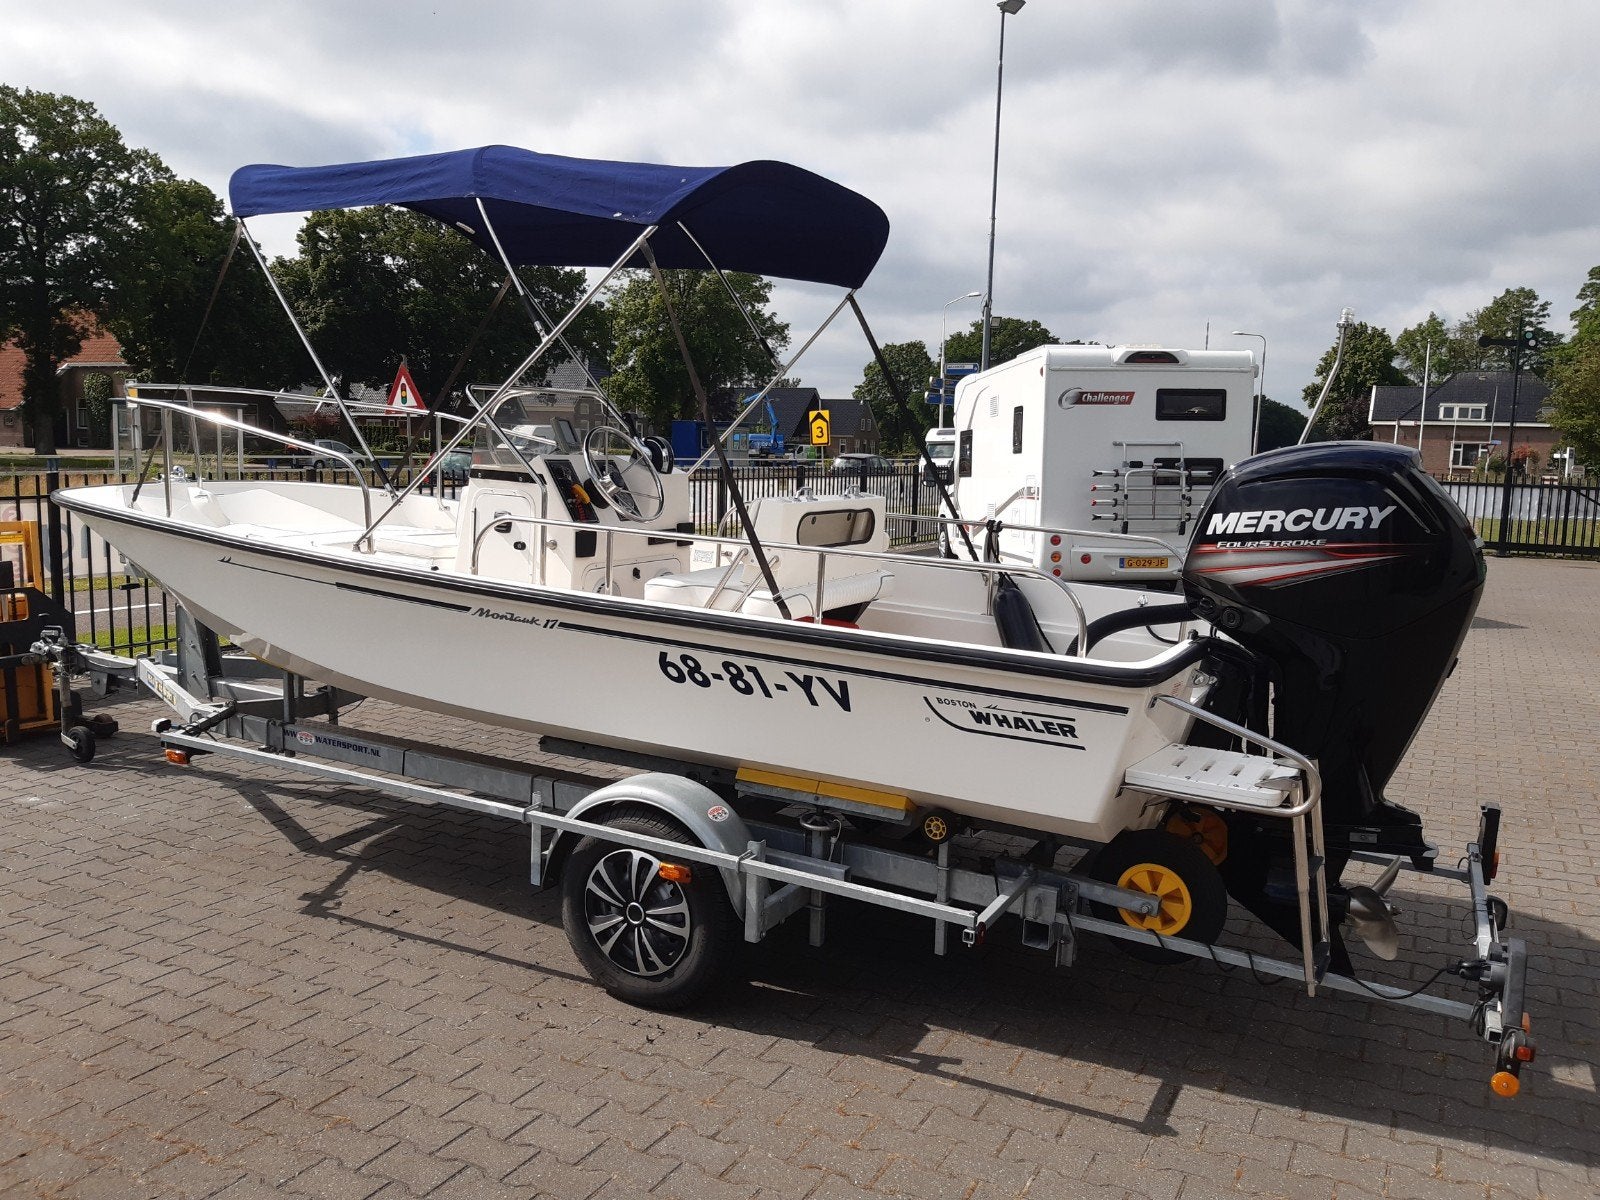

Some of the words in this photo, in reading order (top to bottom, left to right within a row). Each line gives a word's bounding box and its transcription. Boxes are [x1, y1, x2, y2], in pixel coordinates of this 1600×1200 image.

[1082, 392, 1130, 405] Challenger
[815, 426, 825, 439] 3
[1206, 505, 1398, 536] MERCURY
[1216, 538, 1328, 549] FOURSTROKE
[471, 607, 541, 626] Montauk
[542, 618, 559, 630] 17
[658, 651, 851, 712] 68-81-YV
[936, 697, 977, 710] BOSTON
[968, 709, 1079, 739] WHALER
[315, 735, 382, 758] WATERSPORT.NL
